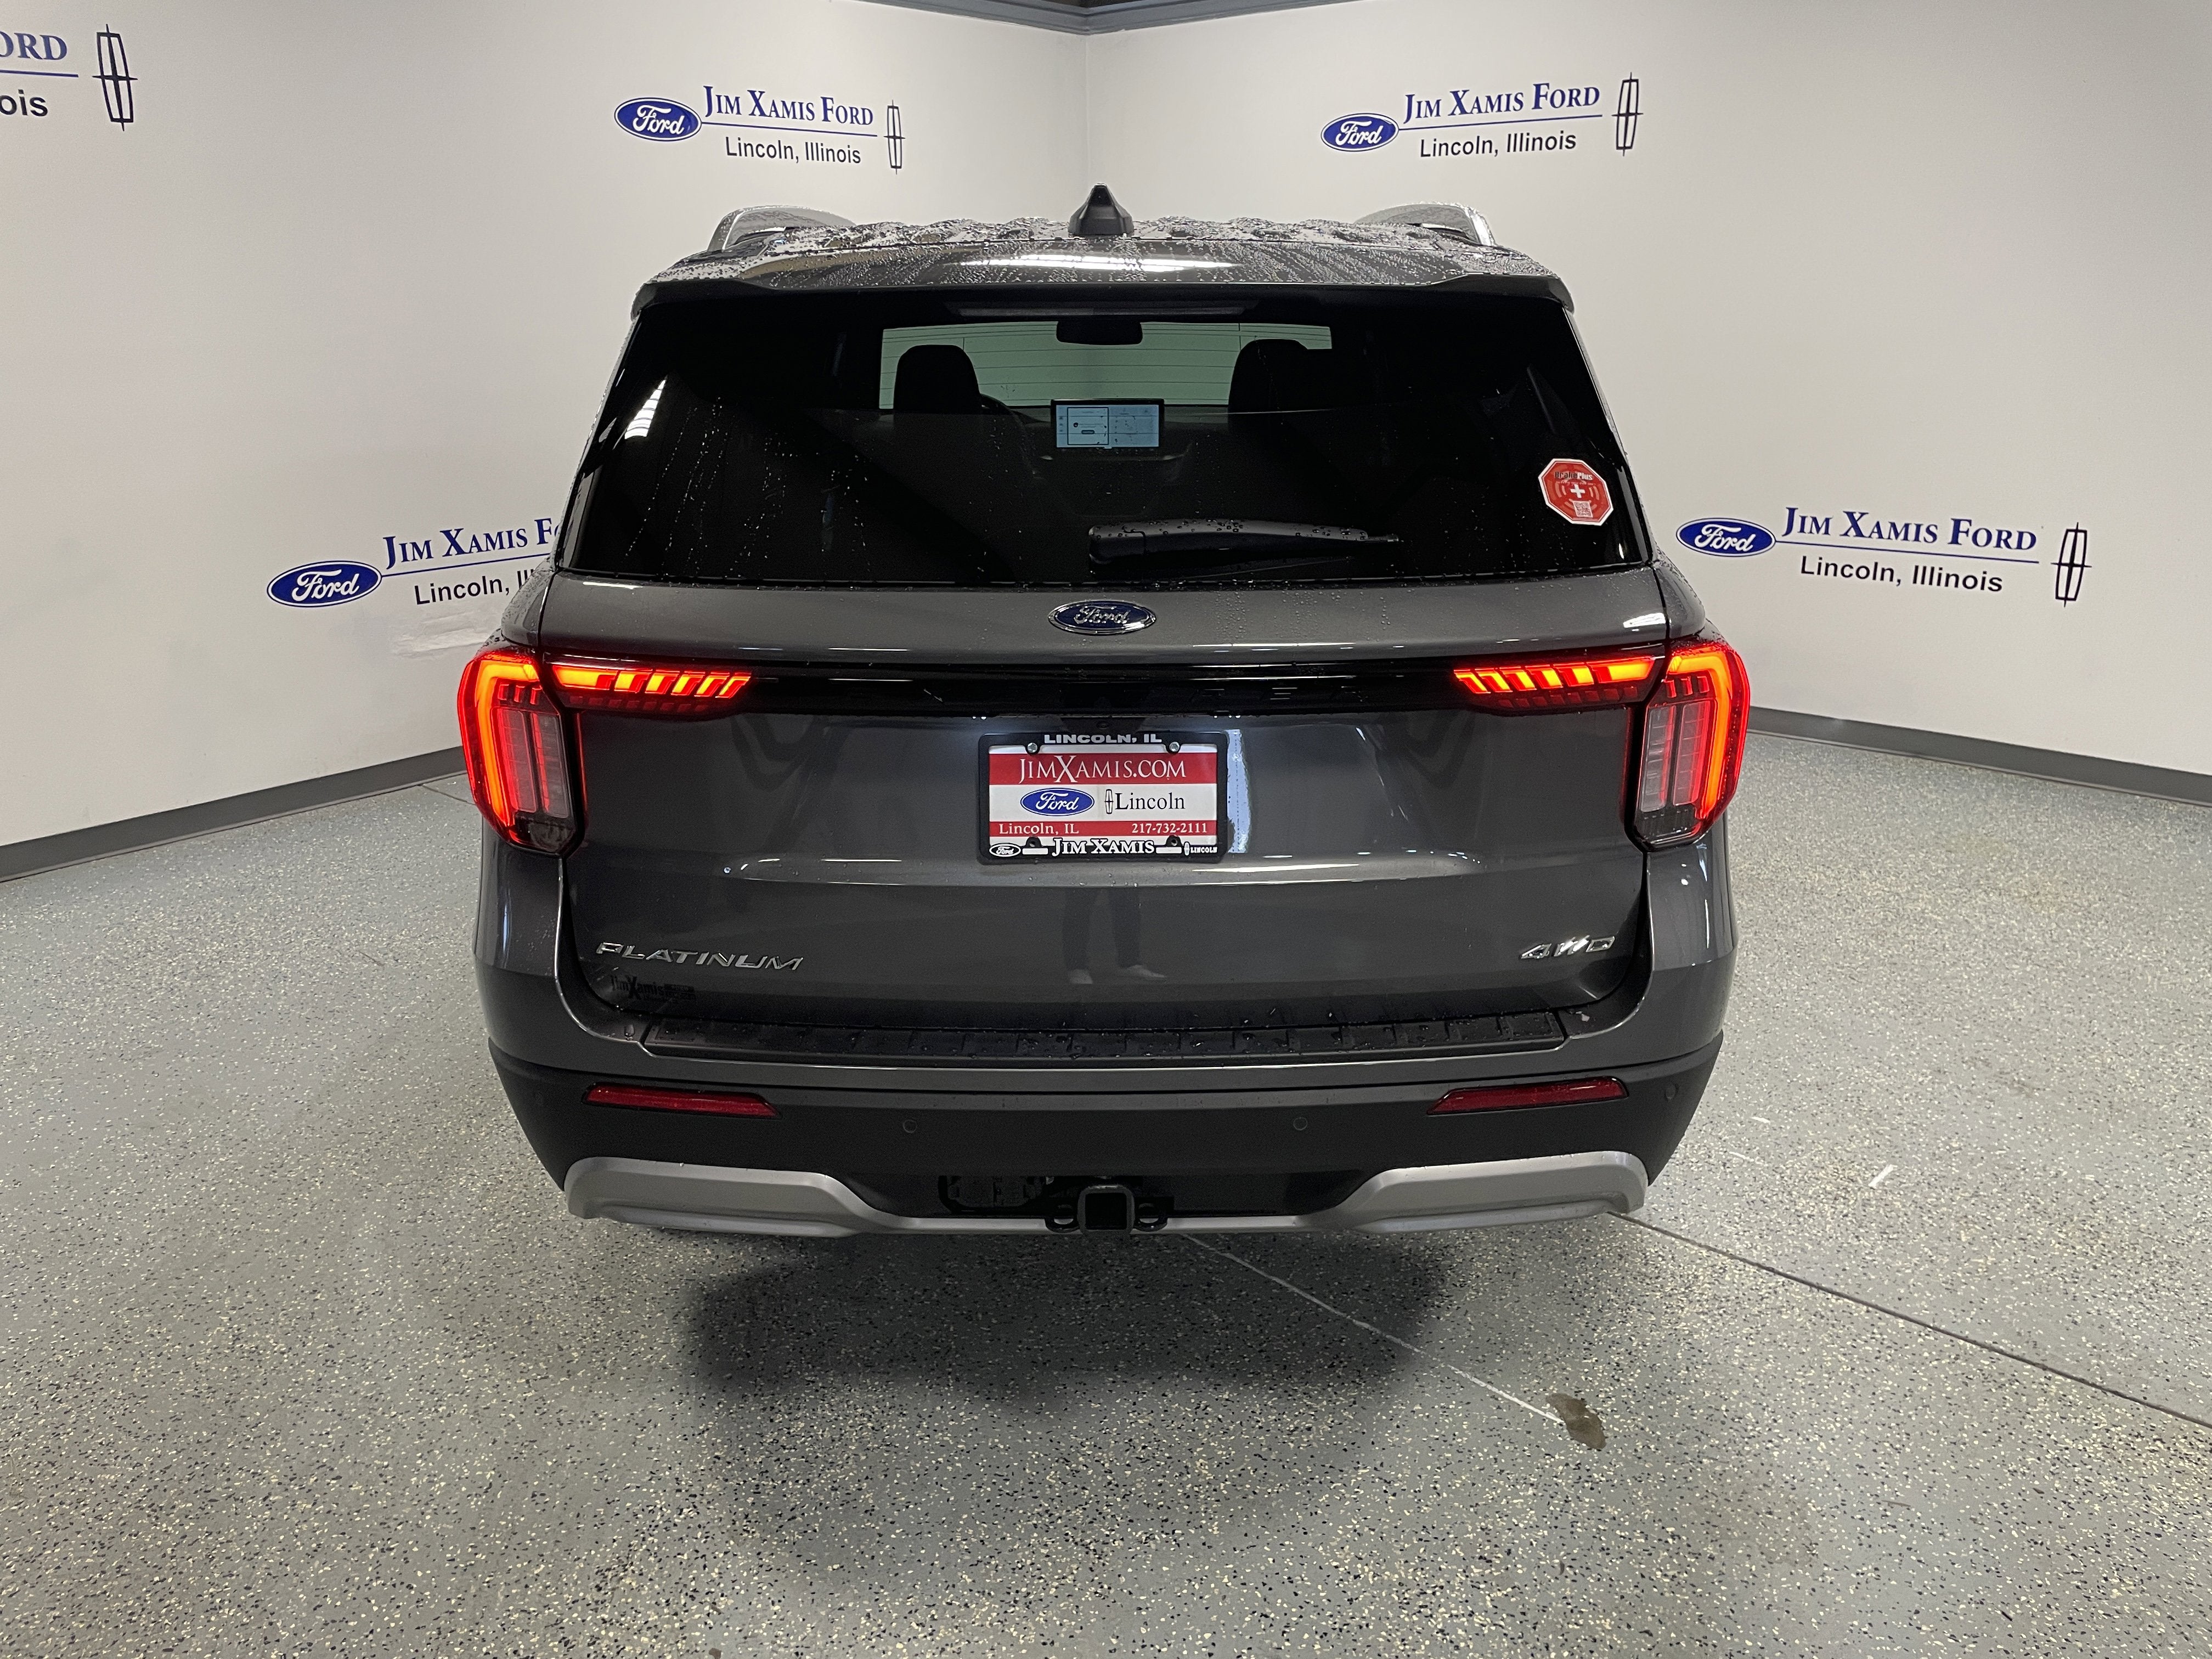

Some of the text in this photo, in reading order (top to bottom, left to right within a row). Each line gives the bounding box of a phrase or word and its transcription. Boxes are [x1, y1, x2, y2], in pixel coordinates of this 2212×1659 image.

[0, 31, 67, 60] ORD
[703, 85, 873, 126] JIM XAMIS FORD
[1402, 82, 1600, 124] JIM XAMIS FORD
[632, 104, 685, 135] Ford
[1335, 120, 1383, 146] Ford
[725, 136, 861, 164] Lincoln, Illinois
[1420, 130, 1576, 157] Lincoln, Illinois
[1694, 523, 1756, 553] Ford
[1781, 507, 2036, 550] JIM XAMIS FORD
[382, 535, 433, 569] JIM
[439, 528, 528, 557] XAMIS
[291, 569, 359, 602] Ford
[1801, 555, 2002, 592] Lincoln, Illinois
[414, 575, 510, 605] Lincoln,
[1074, 605, 1131, 624] Ford
[1044, 733, 1163, 744] LINCOLN, IL
[1019, 755, 1187, 785] JIMXAMIS.COM
[1035, 792, 1079, 811] Ford
[1115, 792, 1186, 810] Lincoln
[999, 823, 1079, 836] Lincoln, IL
[1131, 822, 1207, 833] 217-732-2111
[995, 846, 1015, 856] Ford
[1052, 838, 1155, 857] JIM XAMIS
[596, 942, 803, 970] PLATINUM
[1520, 934, 1615, 959] 4WD
